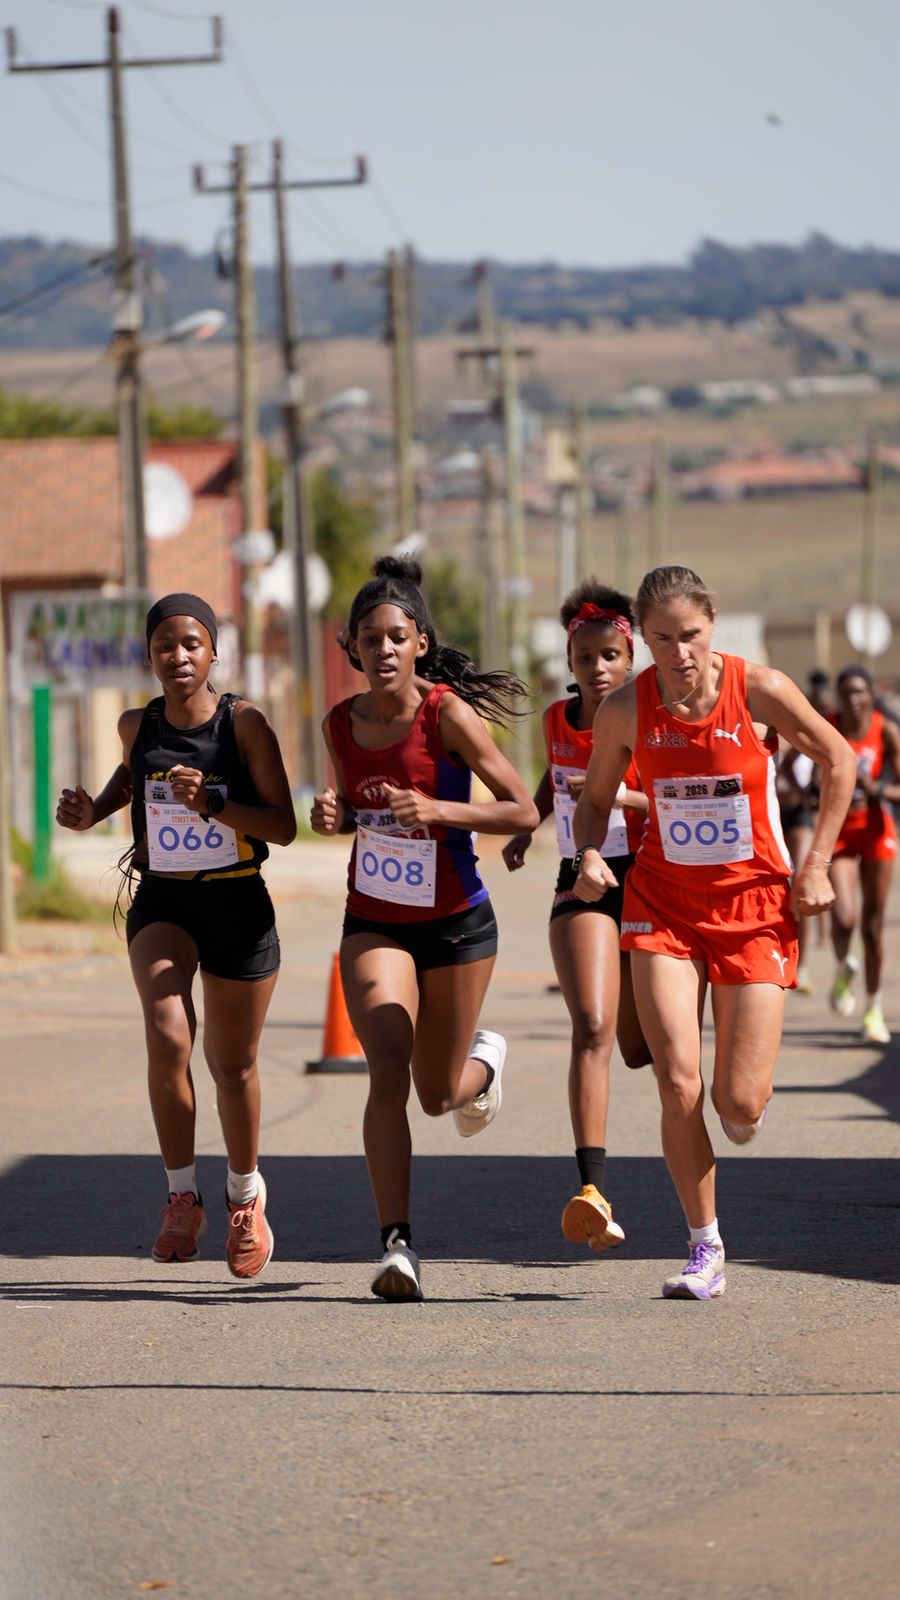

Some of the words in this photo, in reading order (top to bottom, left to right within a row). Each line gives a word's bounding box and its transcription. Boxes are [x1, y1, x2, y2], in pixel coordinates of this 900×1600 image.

[685, 784, 708, 797] 2026
[158, 824, 224, 851] 066
[669, 818, 740, 846] 005
[375, 844, 392, 854] STREET
[392, 847, 404, 856] MILE
[362, 851, 424, 887] 008
[621, 921, 653, 934] OXER
